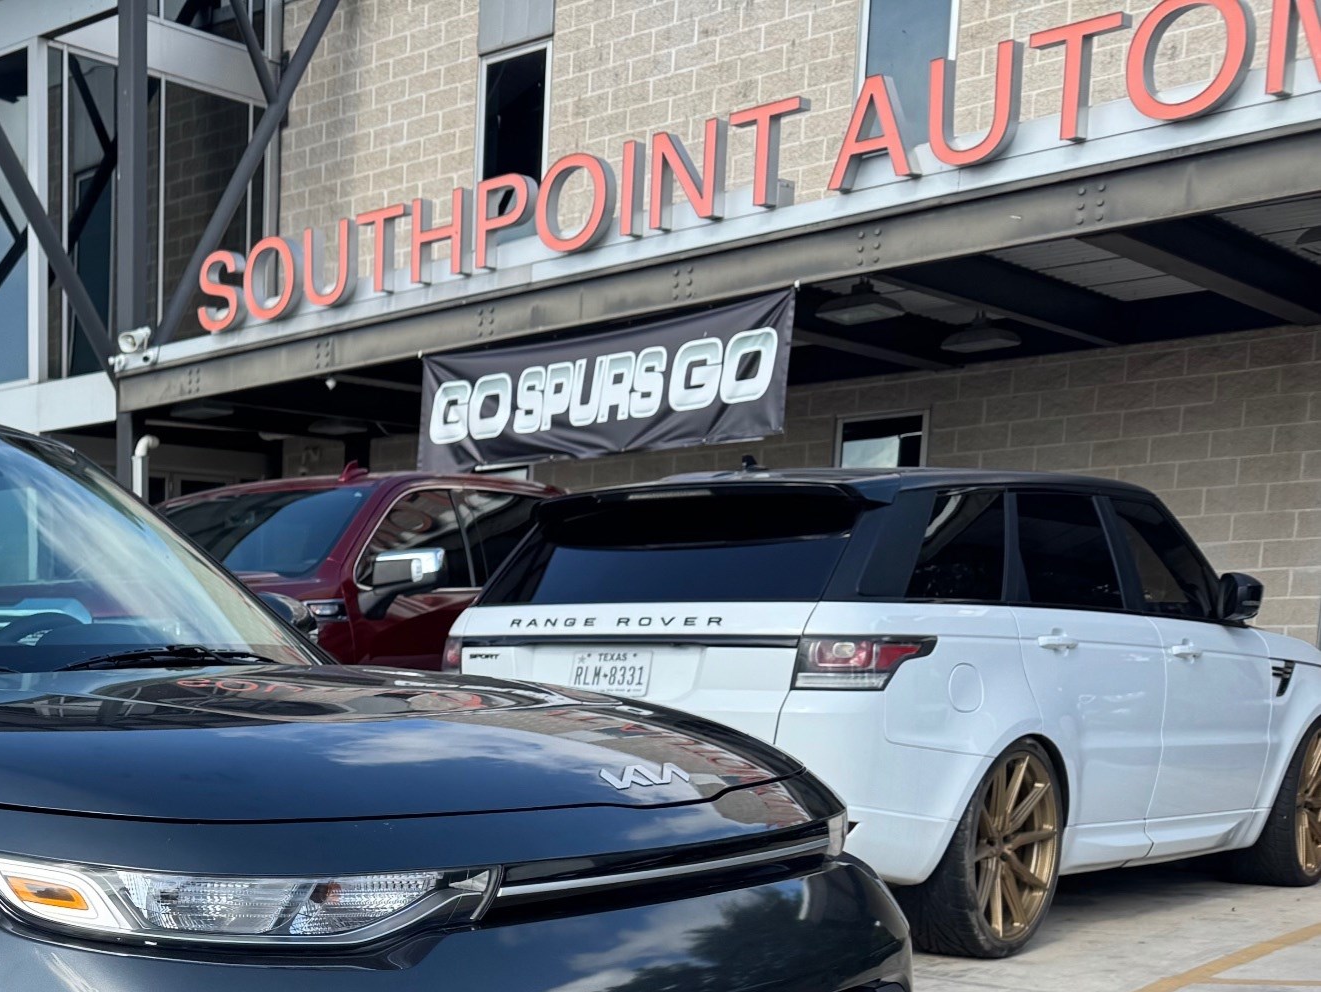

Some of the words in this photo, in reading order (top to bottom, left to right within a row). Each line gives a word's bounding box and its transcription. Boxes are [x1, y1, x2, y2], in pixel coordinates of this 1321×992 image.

[198, 97, 810, 334] SOUTHPOINT
[429, 372, 512, 445] GO
[513, 346, 667, 434] SPURS
[668, 326, 779, 412] GO
[510, 617, 597, 628] RANGE
[616, 616, 724, 627] ROVER
[469, 653, 500, 661] SPORT
[597, 652, 628, 662] TEXAS
